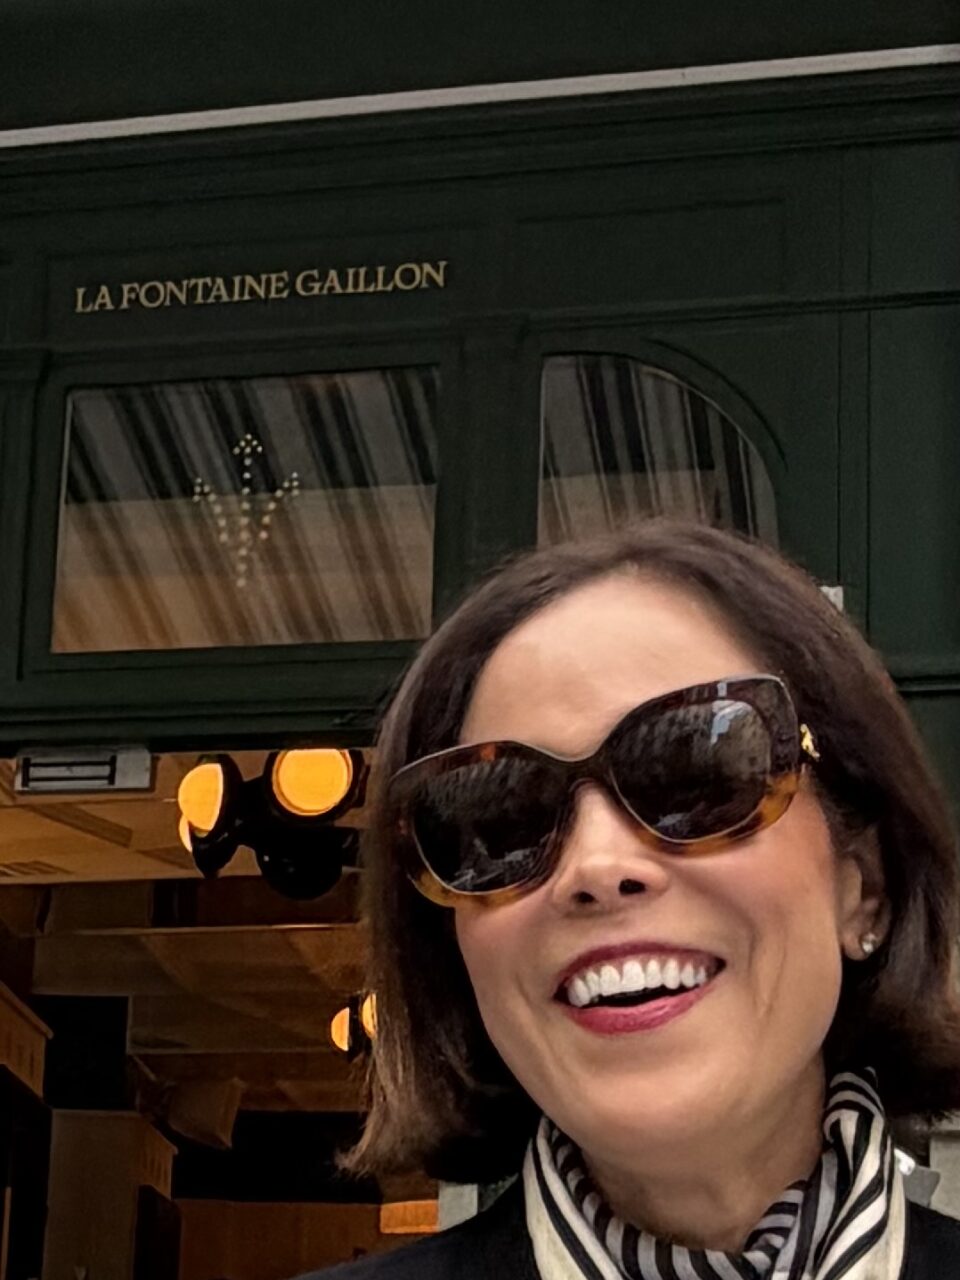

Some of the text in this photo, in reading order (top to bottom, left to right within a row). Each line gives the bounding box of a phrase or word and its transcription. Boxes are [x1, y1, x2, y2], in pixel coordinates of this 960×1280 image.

[75, 260, 448, 313] LA FONTAINE GAILLON
